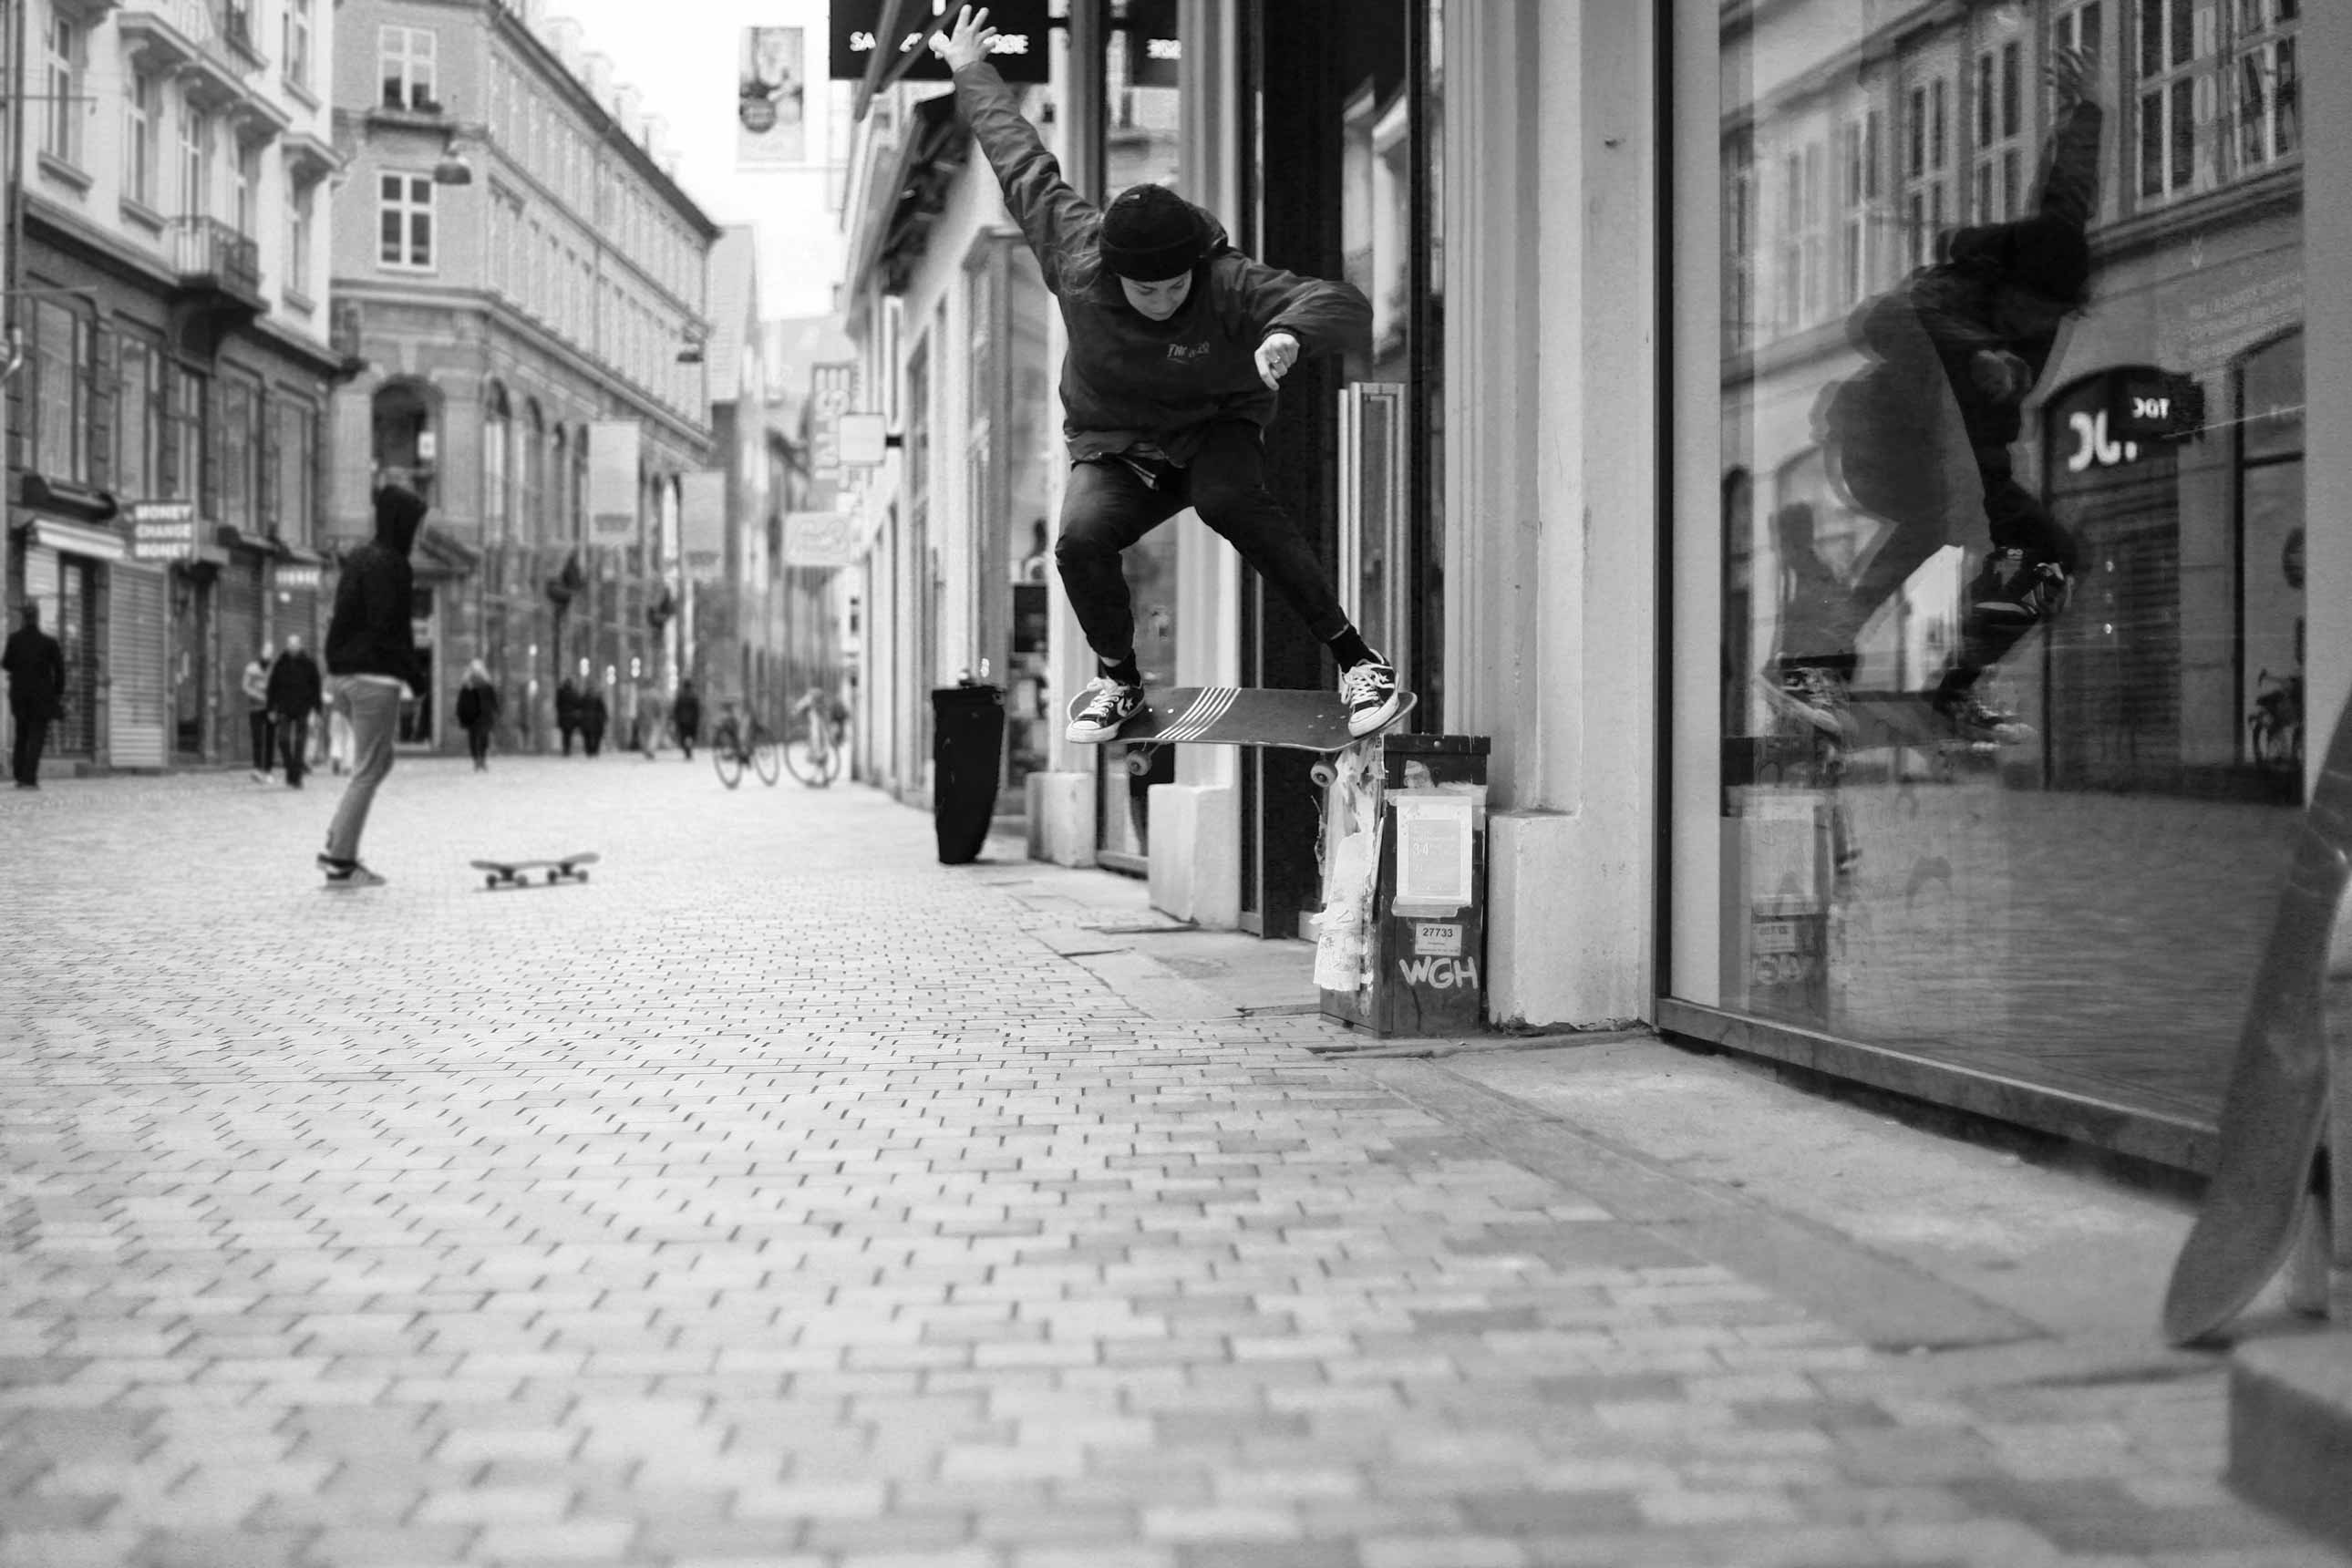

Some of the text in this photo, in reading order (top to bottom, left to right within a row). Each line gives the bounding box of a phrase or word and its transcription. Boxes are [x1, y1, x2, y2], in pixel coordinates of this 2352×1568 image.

[135, 504, 191, 520] MONEY
[135, 523, 191, 539] CHANGE
[135, 542, 191, 558] MONEY
[1421, 926, 1454, 938] 27733
[1398, 955, 1479, 990] WGH
